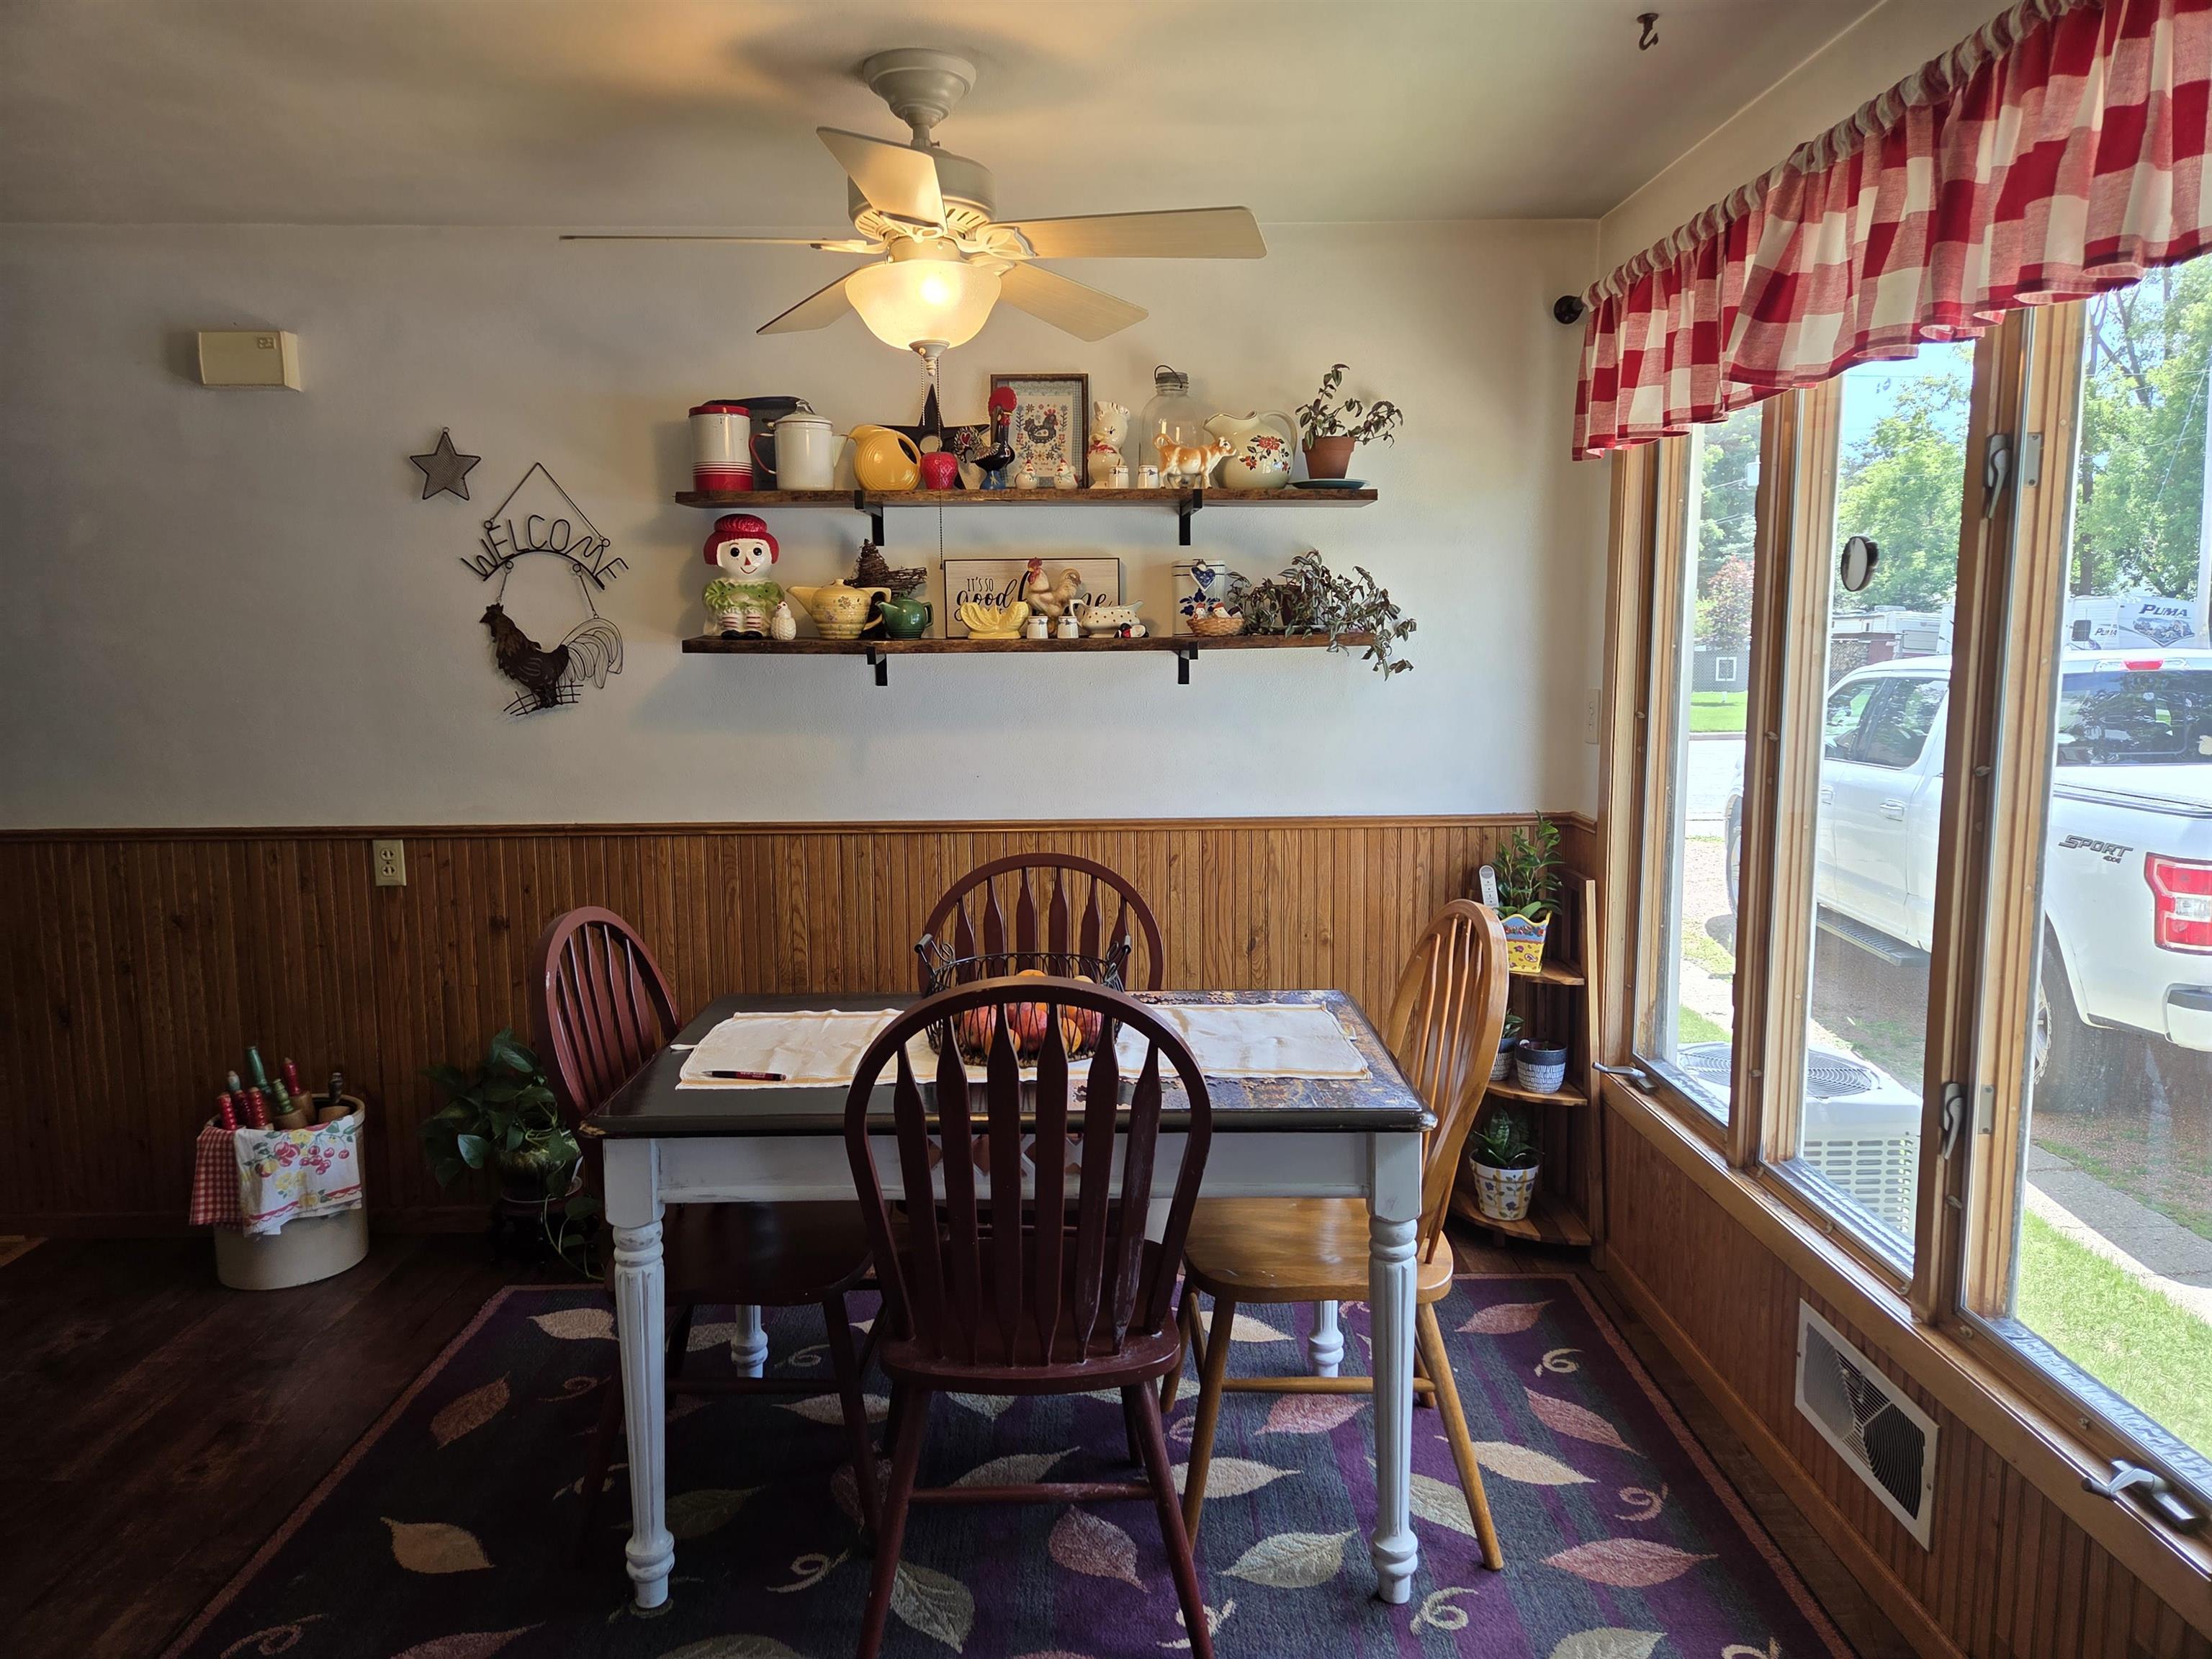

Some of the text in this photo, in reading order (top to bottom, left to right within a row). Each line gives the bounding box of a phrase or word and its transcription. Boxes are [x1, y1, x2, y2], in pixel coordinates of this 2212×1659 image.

[460, 515, 629, 590] WELCOME
[967, 577, 994, 592] IT'S SO
[954, 578, 1017, 621] good
[2139, 603, 2188, 616] PUMA
[2058, 835, 2134, 857] SPORT
